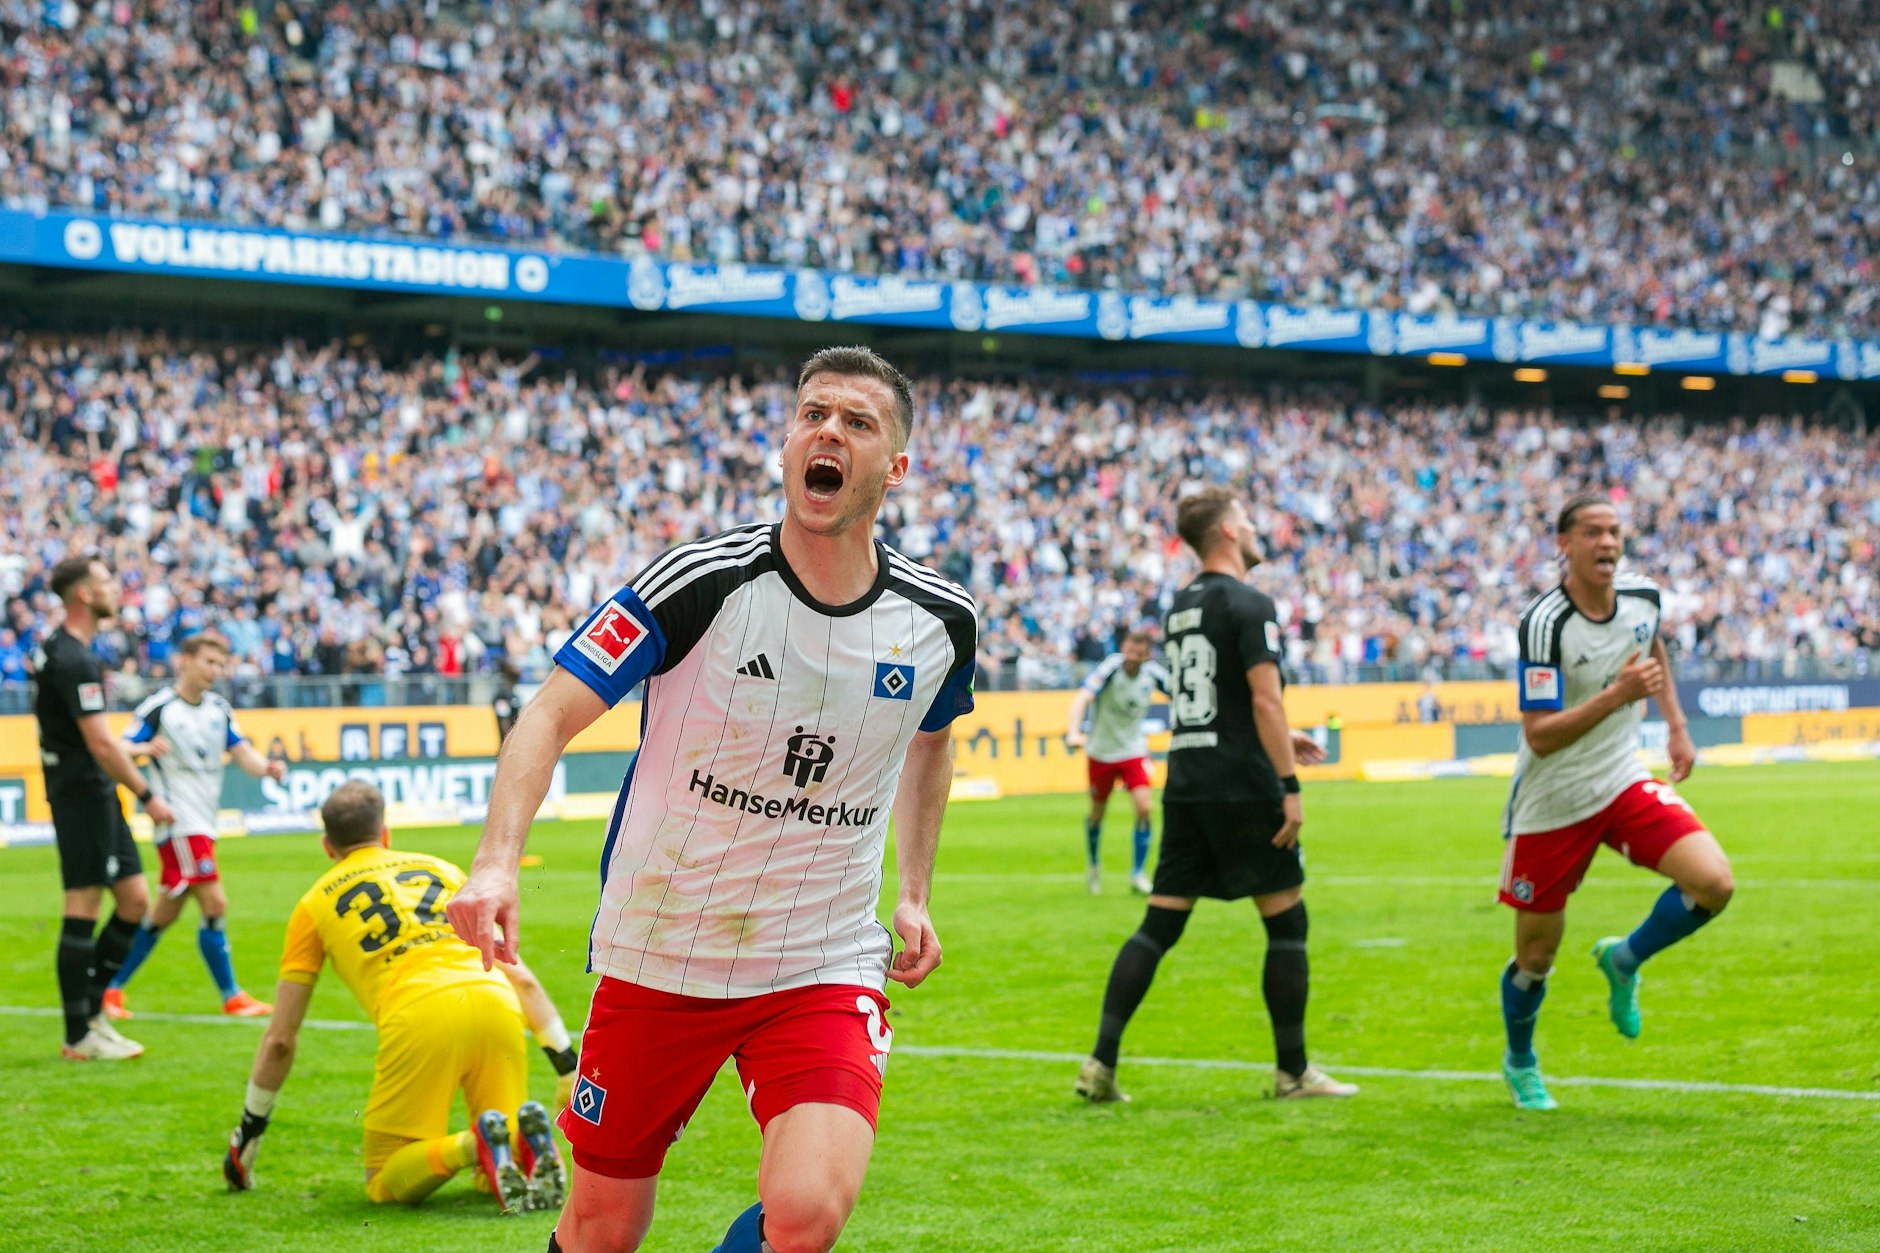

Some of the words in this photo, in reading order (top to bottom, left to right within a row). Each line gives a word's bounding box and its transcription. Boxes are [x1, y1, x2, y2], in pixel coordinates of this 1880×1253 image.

[109, 222, 510, 290] VOLKSPARKSTADION
[579, 639, 613, 668] BUNDESLIGA
[689, 769, 879, 827] HanseMerkur
[335, 869, 449, 952] 32
